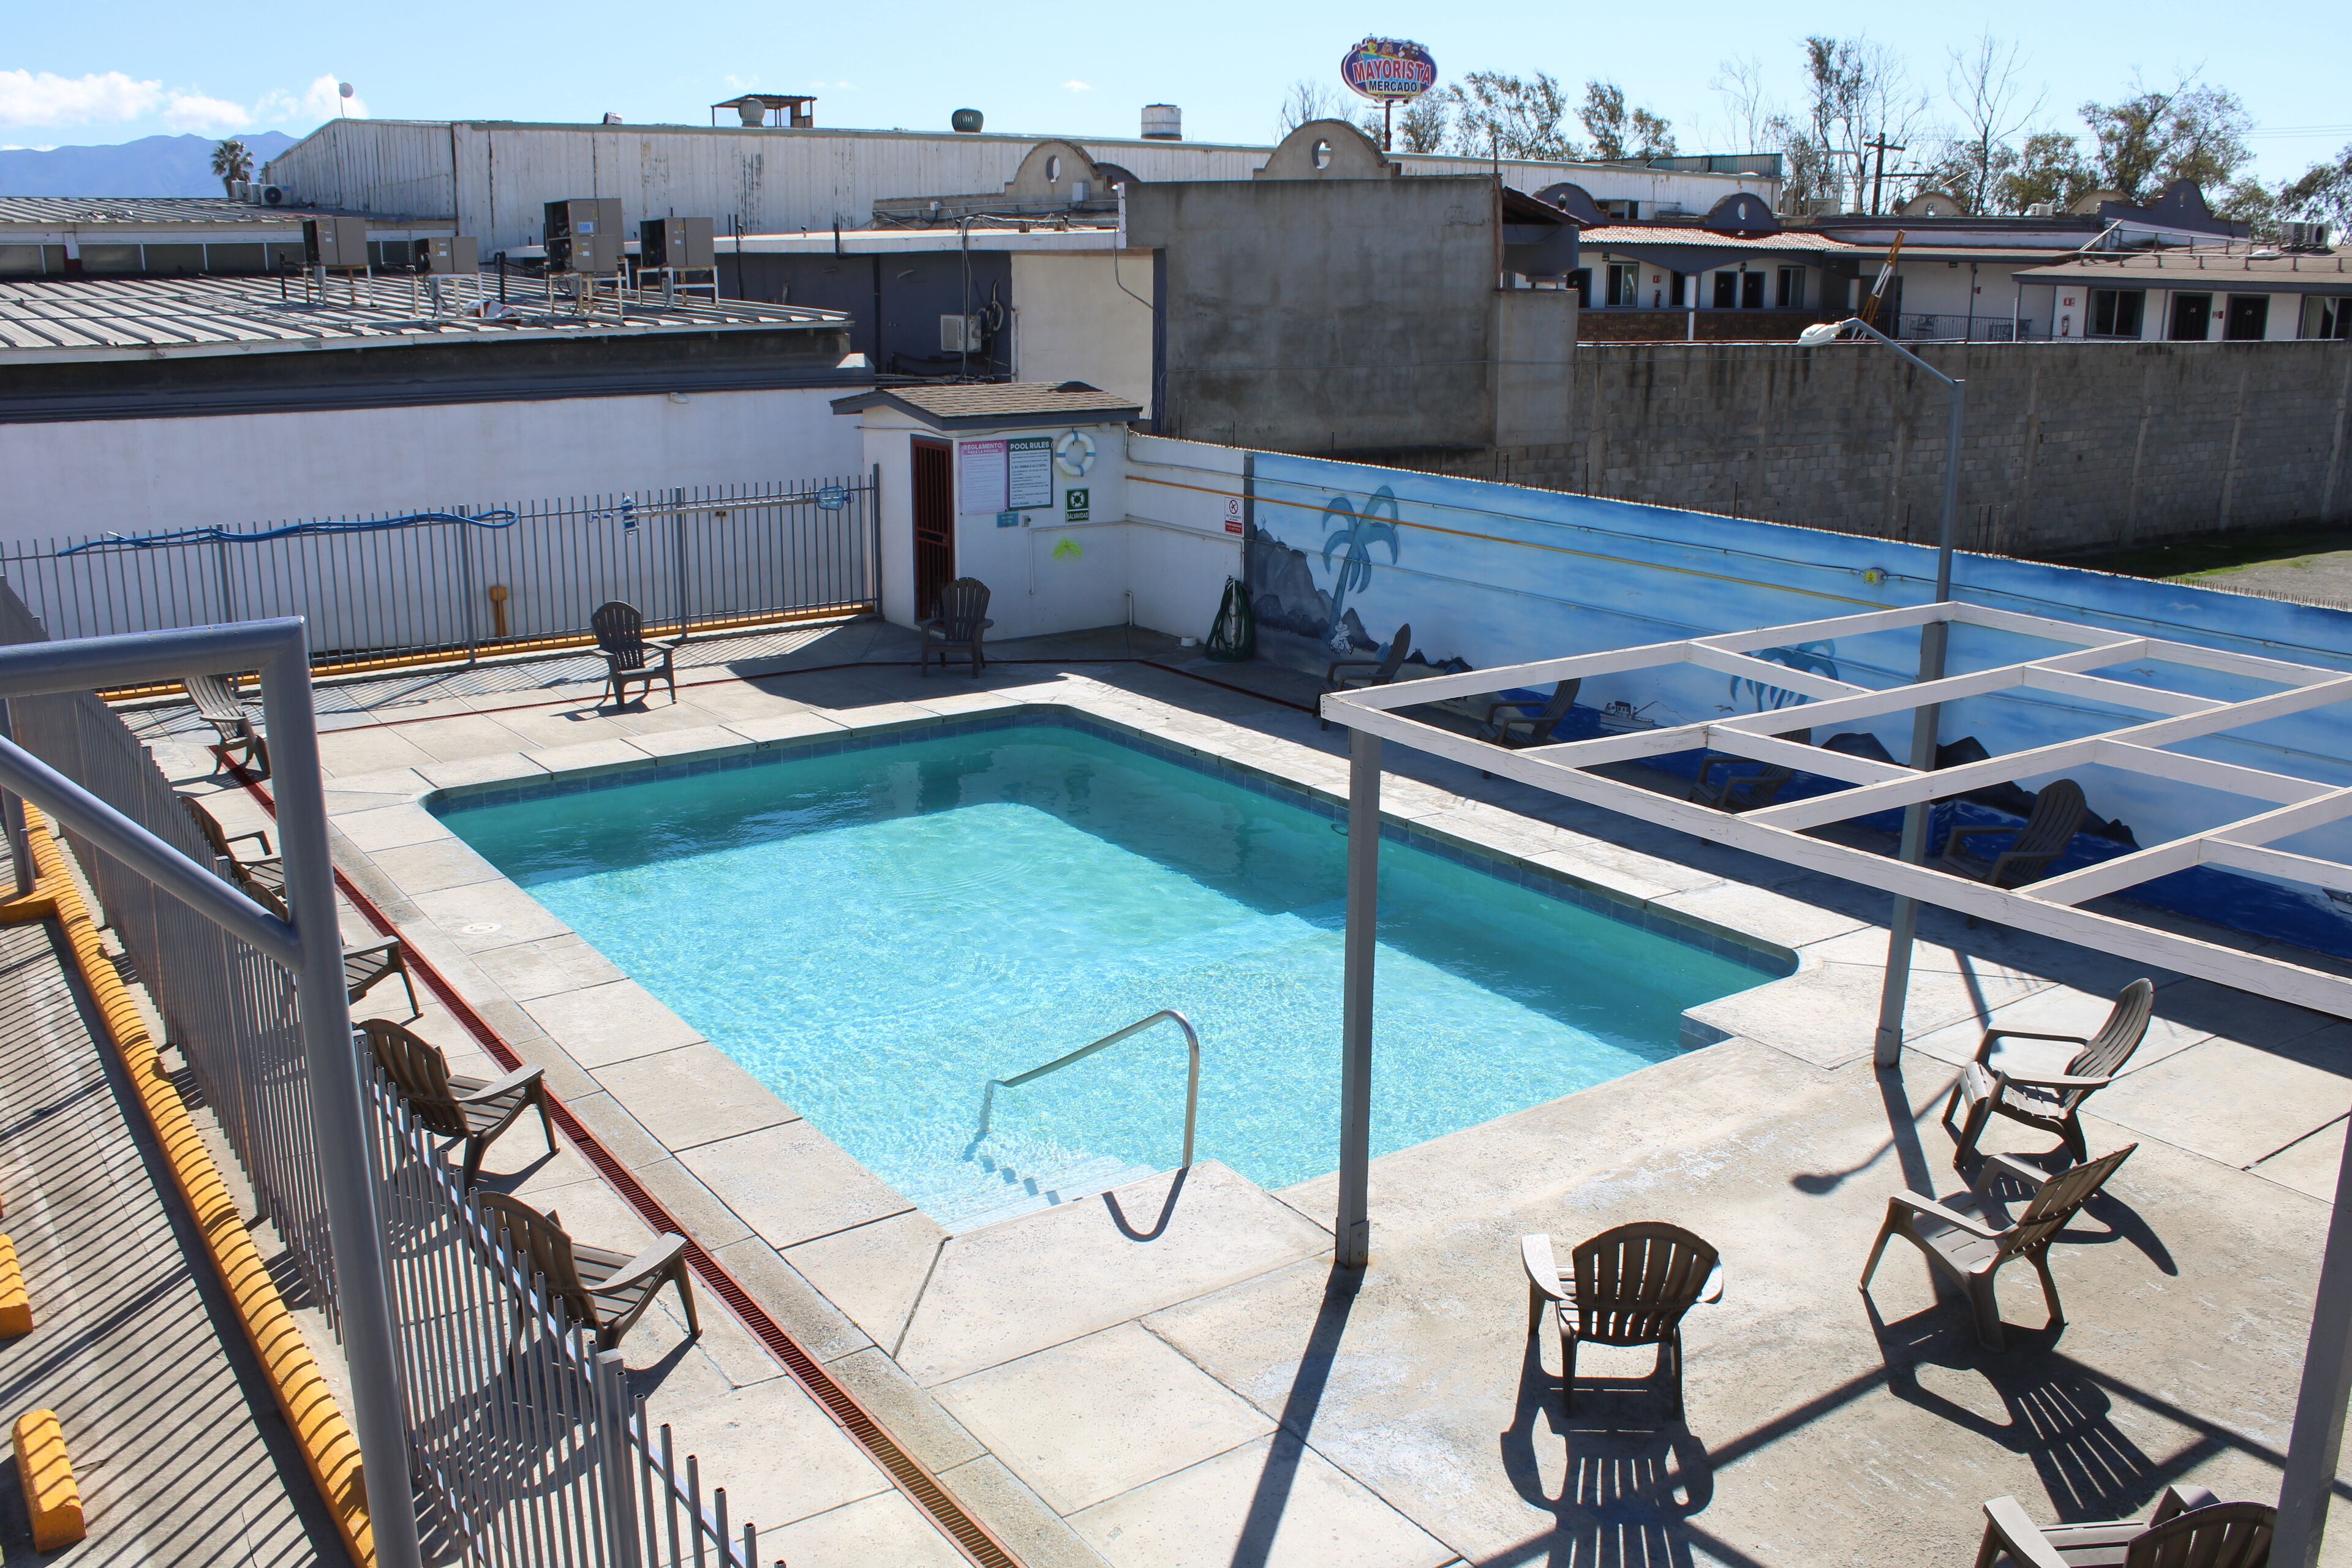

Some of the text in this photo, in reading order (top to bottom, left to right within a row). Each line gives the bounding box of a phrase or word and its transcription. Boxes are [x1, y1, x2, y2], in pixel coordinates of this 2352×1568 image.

[1352, 59, 1431, 86] MAYORISTA
[1369, 80, 1417, 92] MERCADO
[963, 442, 1002, 451] REGLAMENTO
